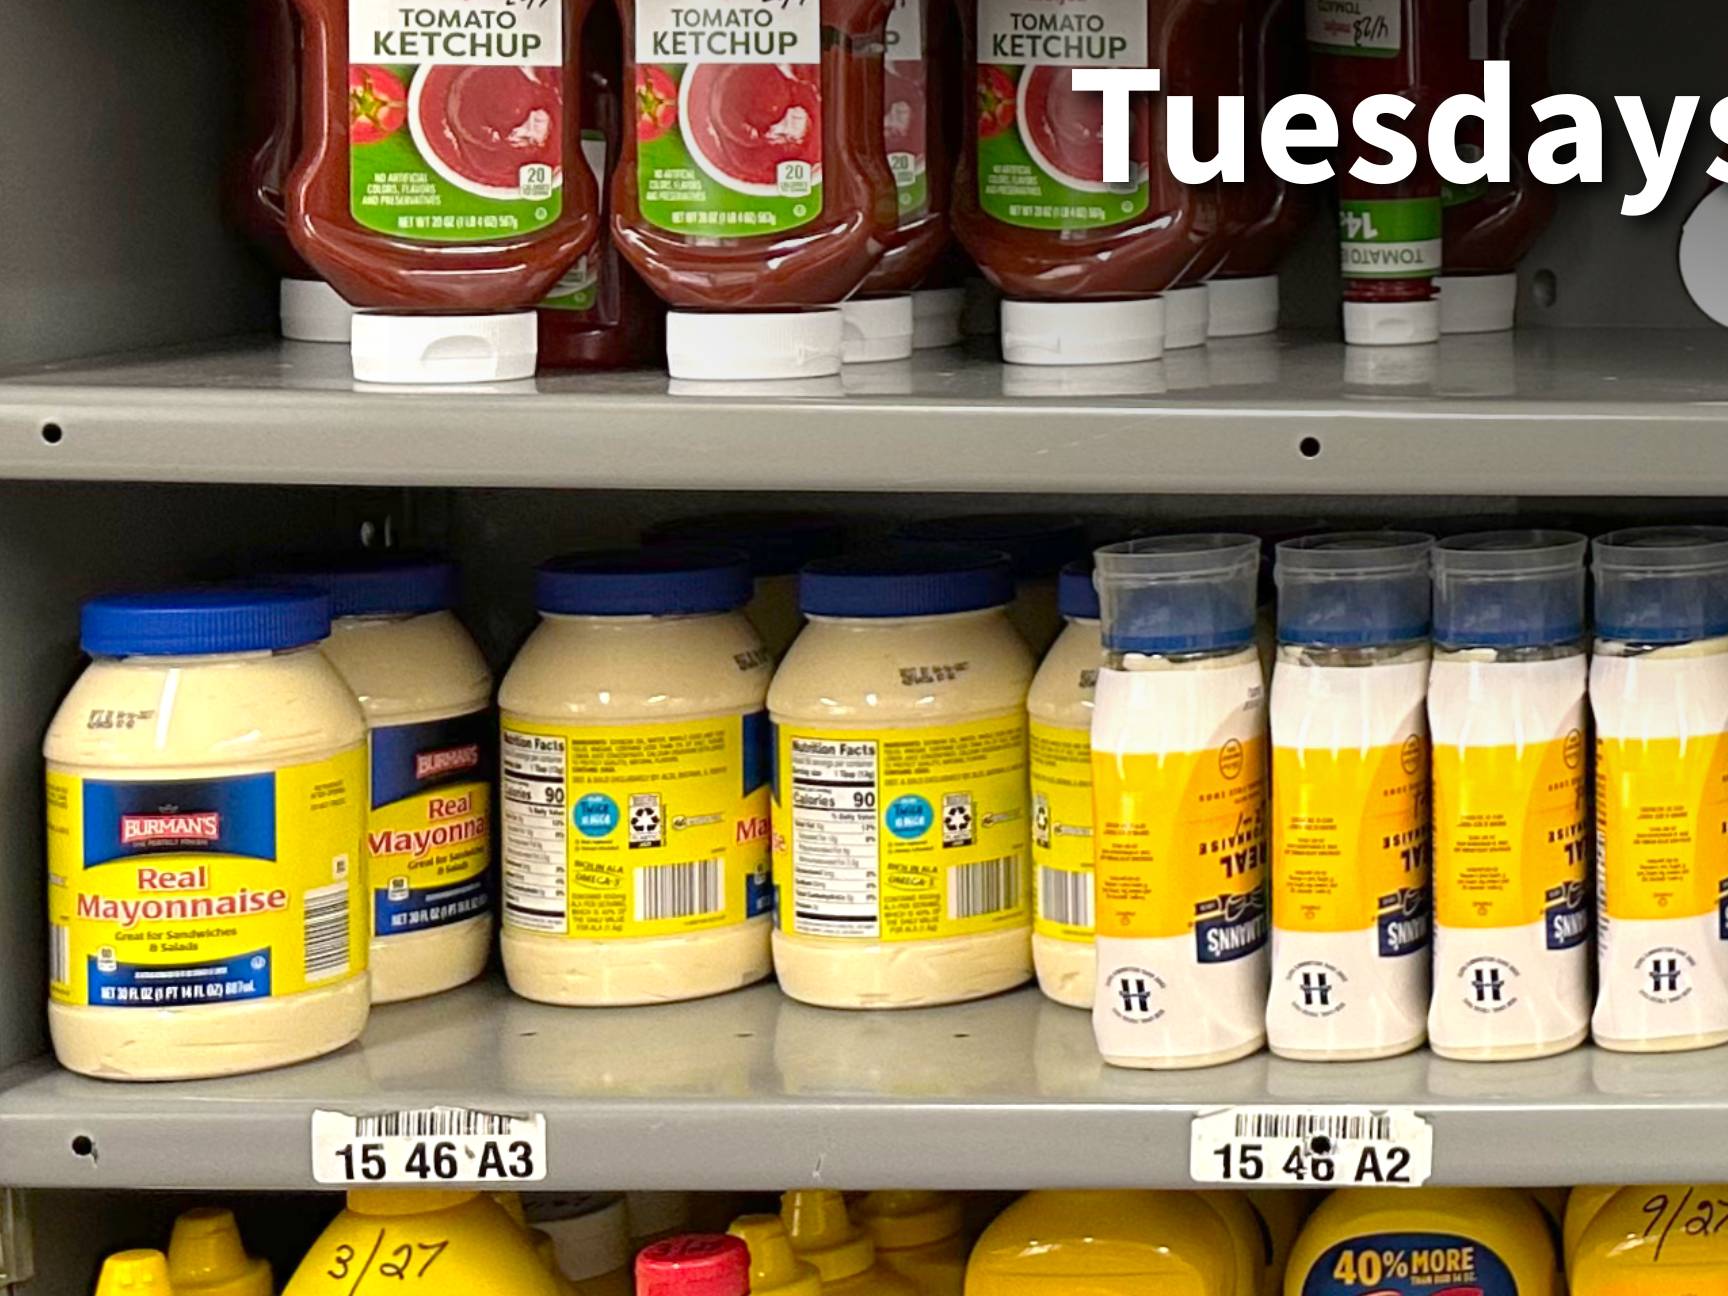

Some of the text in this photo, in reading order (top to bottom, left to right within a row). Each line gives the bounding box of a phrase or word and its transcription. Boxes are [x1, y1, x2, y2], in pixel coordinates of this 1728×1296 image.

[398, 8, 517, 31] TOMATO
[372, 30, 543, 59] KETCHUP
[123, 815, 218, 841] BURMAN'S
[137, 866, 208, 891] Real
[76, 889, 287, 927] Mayonnaise
[334, 1140, 534, 1182] 15 46 A3
[1213, 1143, 1412, 1183] 15 46 A2
[1332, 1245, 1476, 1286] 40% MORE
